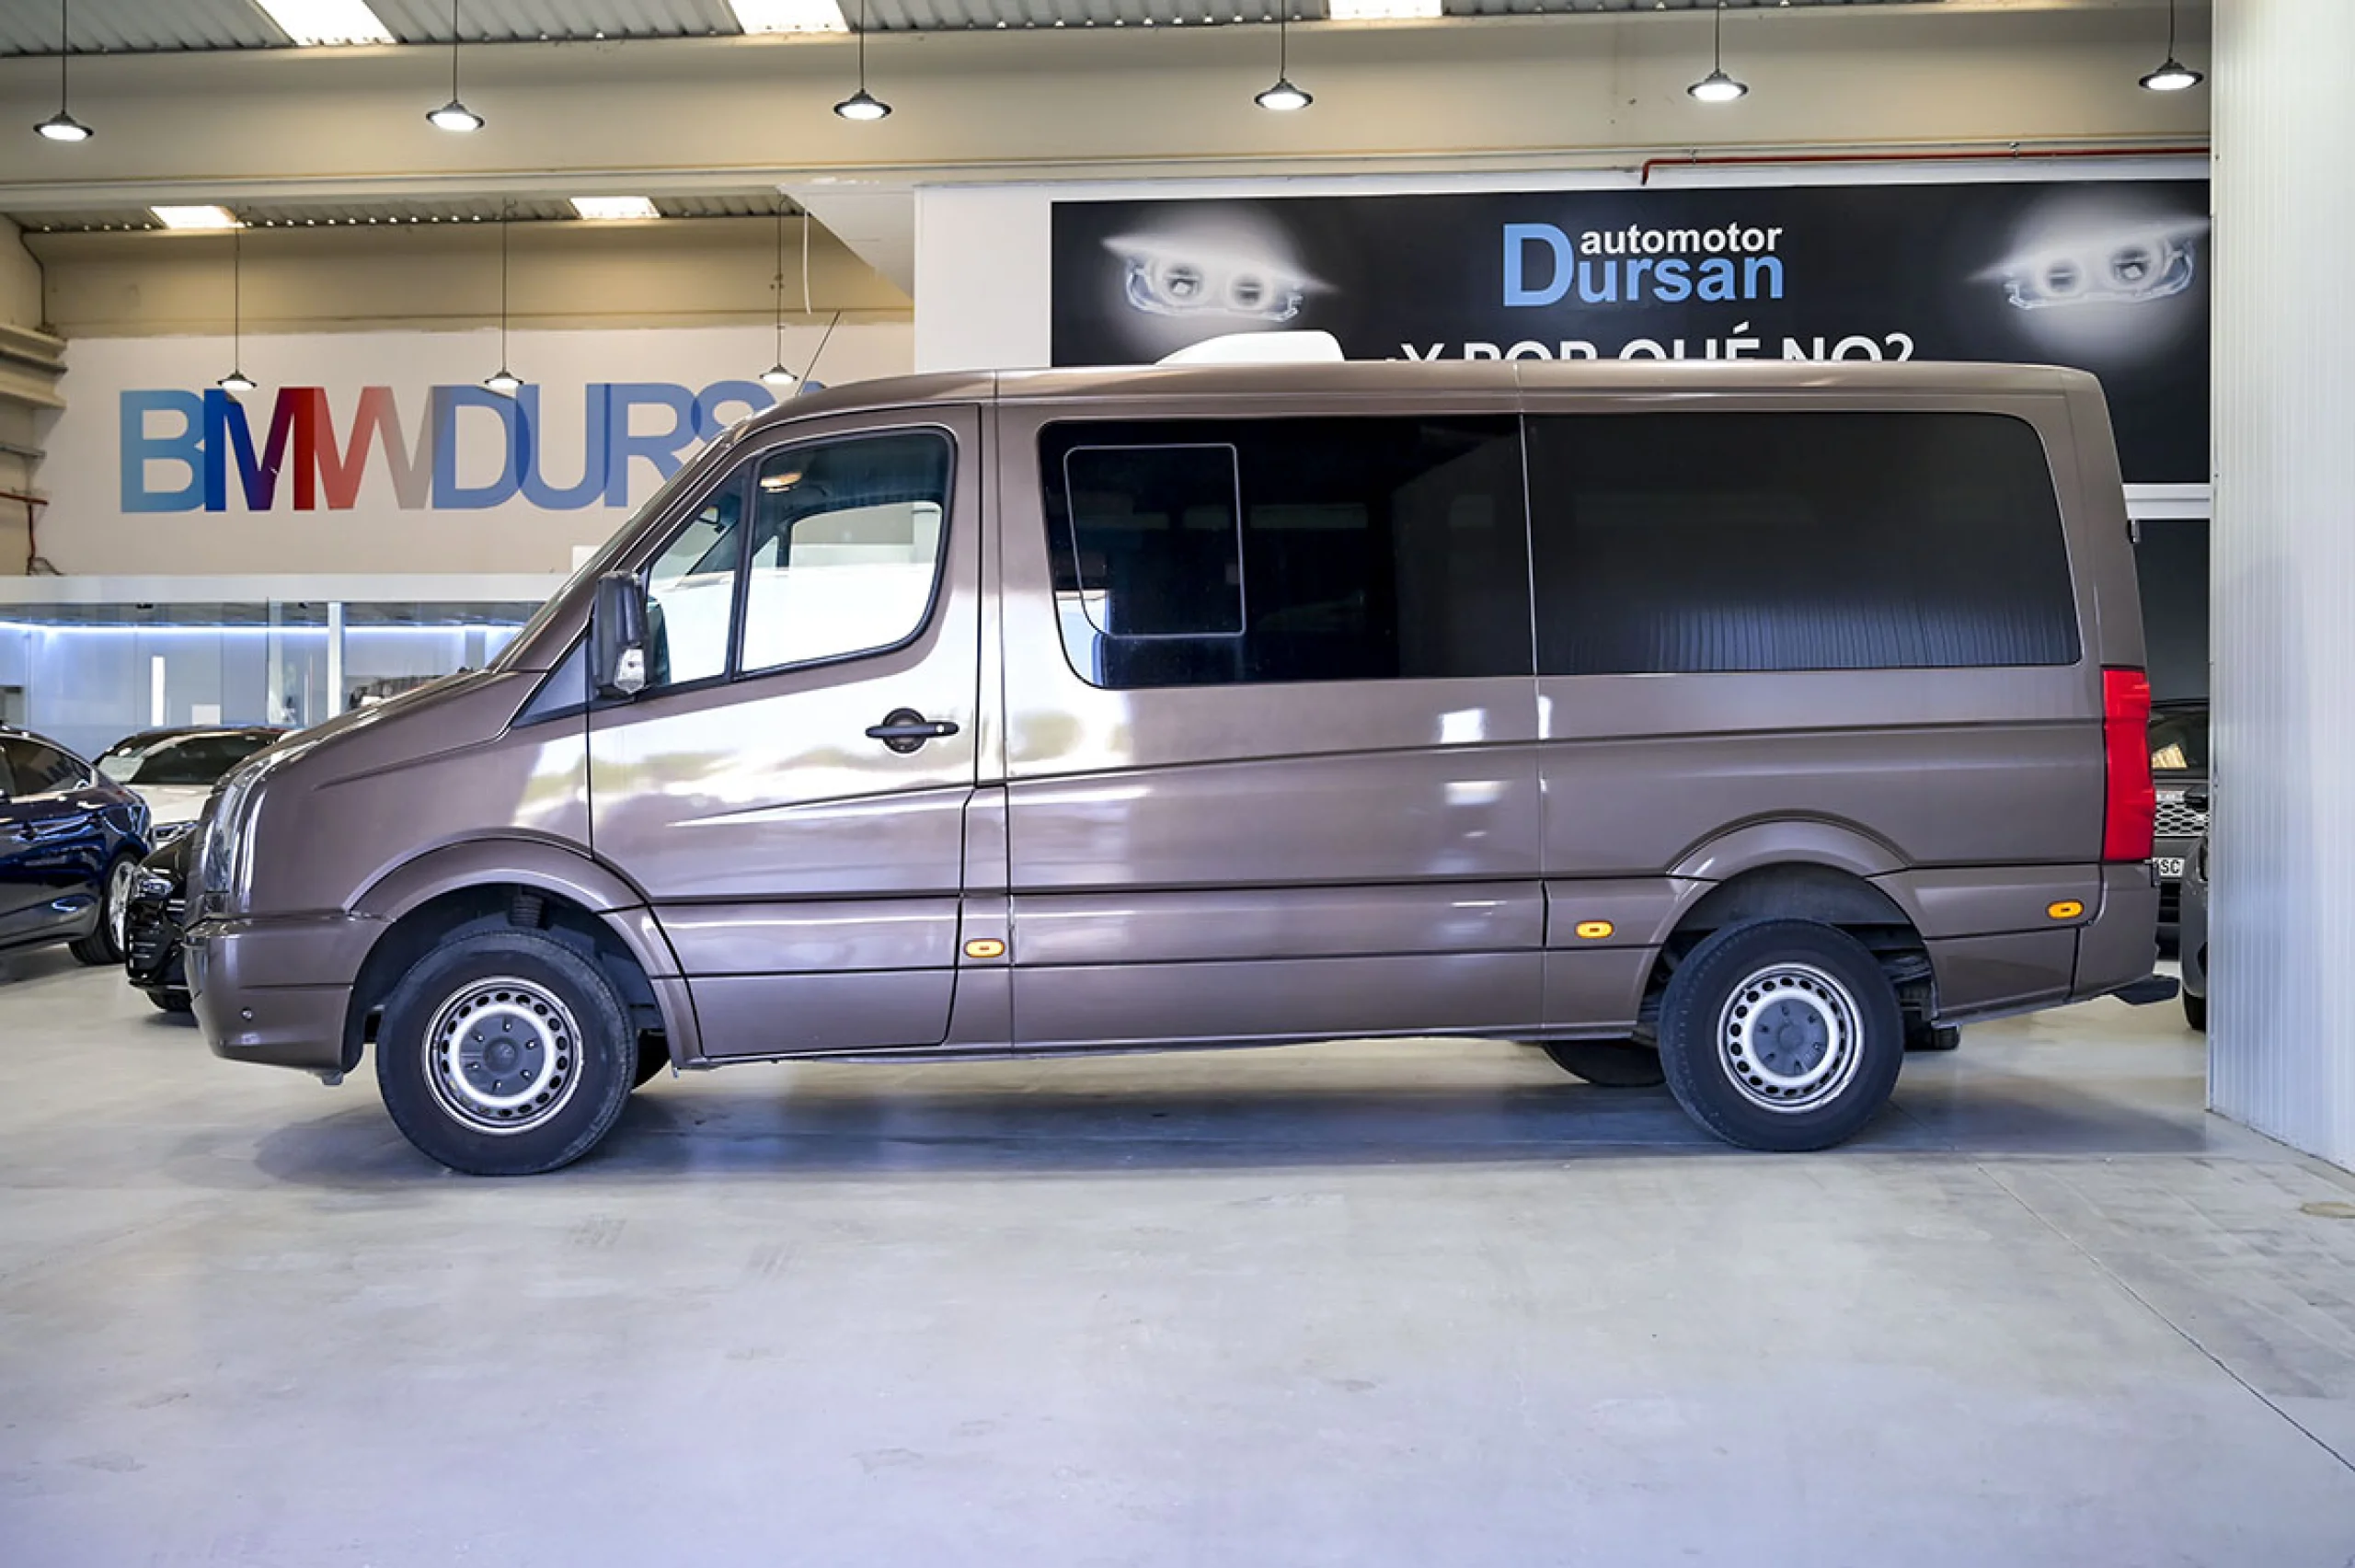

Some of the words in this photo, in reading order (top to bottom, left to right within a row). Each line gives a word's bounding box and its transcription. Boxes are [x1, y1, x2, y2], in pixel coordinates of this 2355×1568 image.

[1580, 222, 1783, 254] automotor
[1502, 223, 1784, 306] Dursan
[2153, 858, 2180, 874] SC
